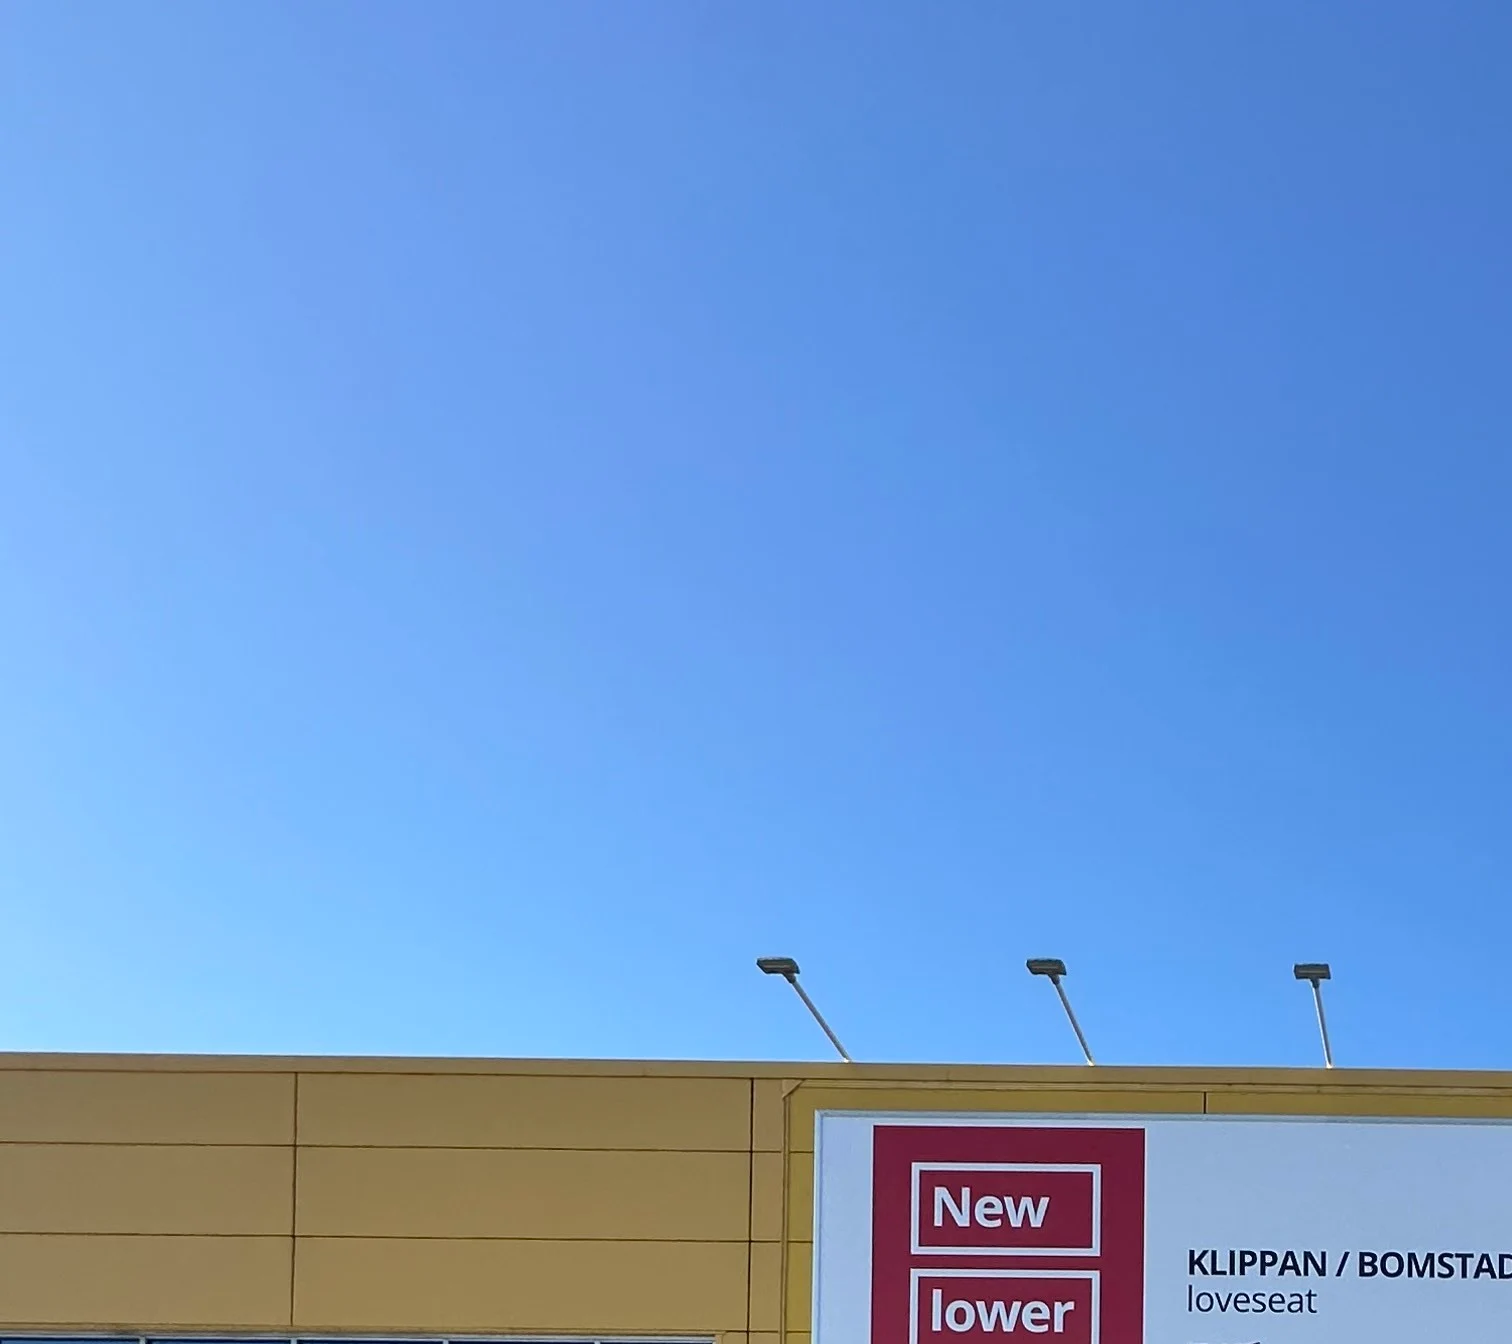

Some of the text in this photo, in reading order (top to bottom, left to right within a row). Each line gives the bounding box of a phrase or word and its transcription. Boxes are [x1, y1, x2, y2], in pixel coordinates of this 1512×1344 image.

[933, 1186, 1050, 1228] New
[1188, 1249, 1327, 1276] KLIPPAN
[1335, 1251, 1350, 1276] /
[931, 1288, 1075, 1333] lower
[1188, 1285, 1317, 1313] loveseat
